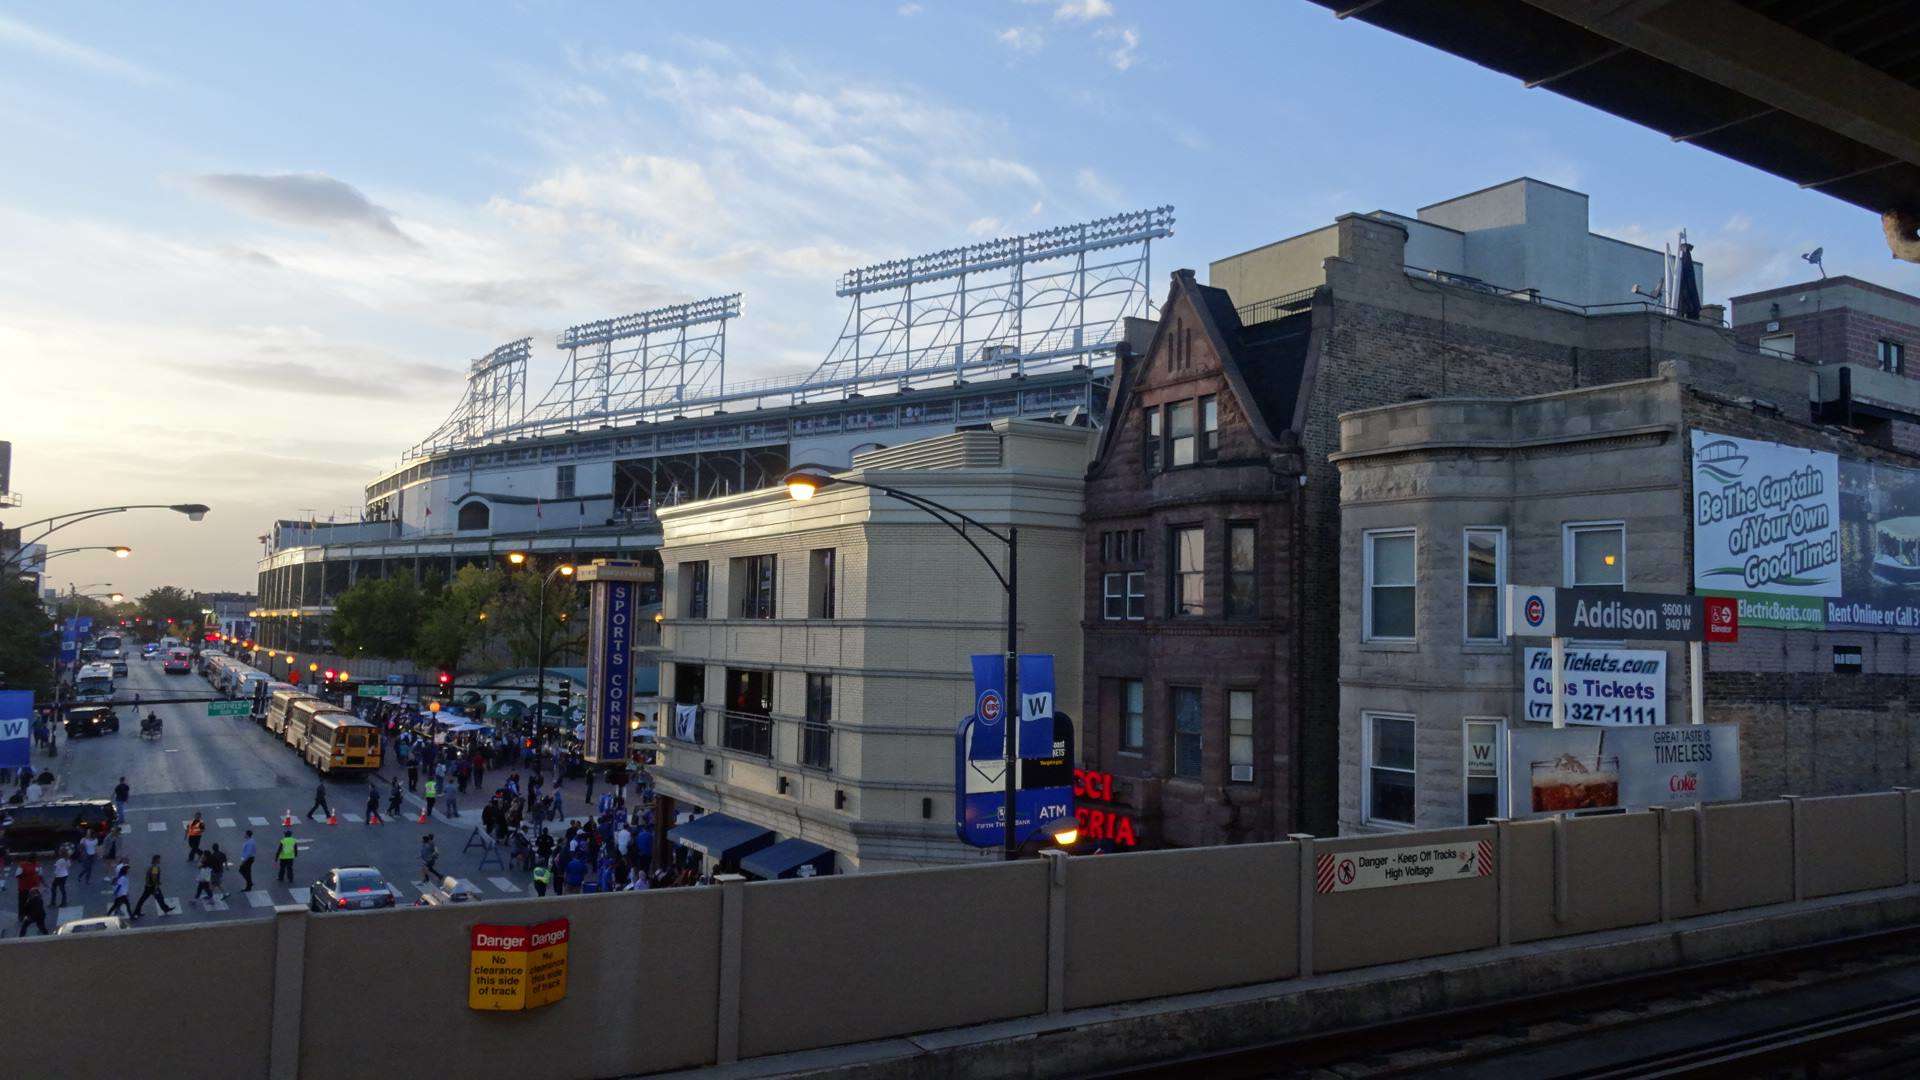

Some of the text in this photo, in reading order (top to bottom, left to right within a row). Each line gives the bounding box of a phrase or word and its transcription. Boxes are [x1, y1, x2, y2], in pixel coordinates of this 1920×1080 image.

[1698, 464, 1824, 526] Be The Captain
[1729, 503, 1829, 556] of Your Own
[1744, 531, 1838, 588] Good Time!
[1573, 599, 1658, 630] Addison
[1662, 603, 1691, 616] 3600 N
[1738, 598, 1822, 623] ElectricBoats.com
[1828, 602, 1852, 623] Rent
[1852, 603, 1884, 625] Online
[1884, 609, 1895, 625] or
[1895, 606, 1913, 626] Call
[1665, 618, 1692, 631] 940 W
[608, 585, 626, 754] SPORTS CORNER
[1530, 651, 1660, 675] FinTickets.com
[1533, 677, 1655, 700] Cus Tickets
[1029, 696, 1046, 716] W
[1529, 701, 1657, 725] (77) 327-1111
[4, 721, 23, 737] W
[1654, 731, 1679, 744] GREAT
[1681, 729, 1703, 743] TASTE
[1472, 744, 1491, 760] W
[1655, 743, 1713, 764] TIMELESS
[1670, 774, 1697, 792] Coke
[1039, 804, 1067, 819] ATM
[1359, 856, 1389, 869] Danger
[1398, 853, 1418, 865] Keep
[1420, 850, 1432, 862] Off
[1433, 849, 1457, 861] Tracks
[1385, 866, 1434, 880] High Voltage
[477, 933, 525, 949] Danger
[531, 929, 566, 946] Danger
[491, 955, 506, 965] No
[474, 966, 524, 975] clearance
[477, 976, 519, 986] this side
[478, 987, 517, 996] of track
